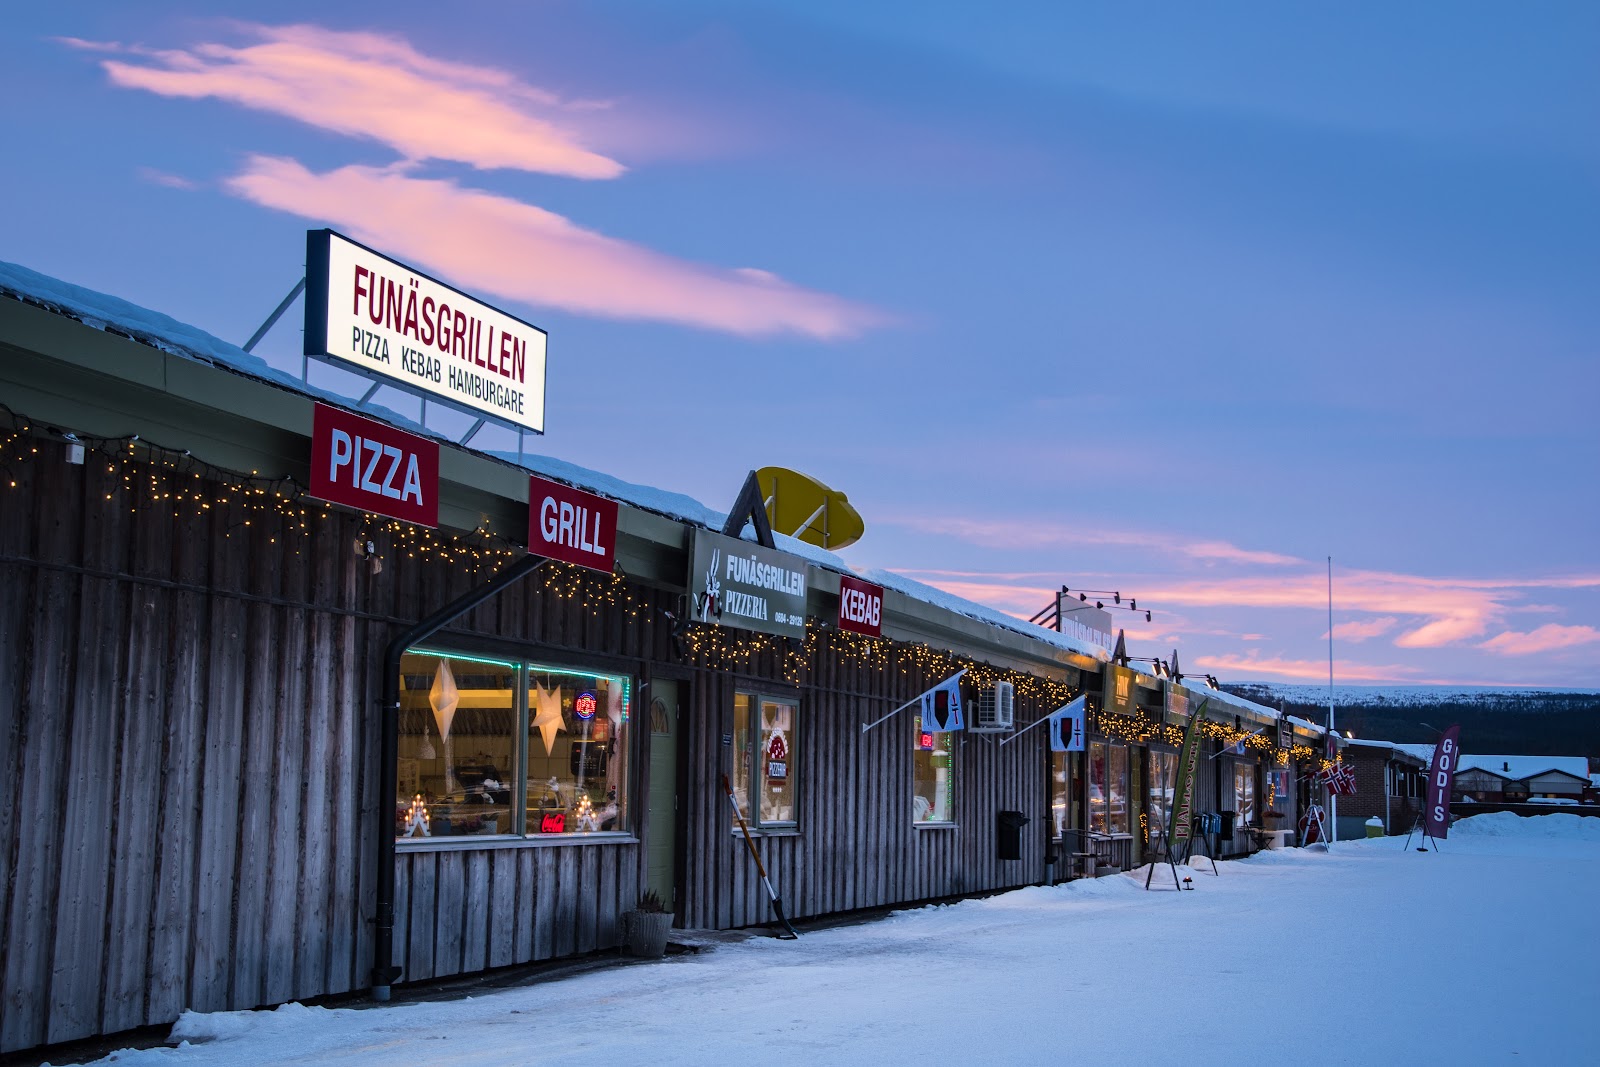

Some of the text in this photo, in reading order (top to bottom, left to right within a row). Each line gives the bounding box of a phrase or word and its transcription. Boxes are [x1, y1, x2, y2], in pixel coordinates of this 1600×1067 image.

[353, 264, 527, 384] FUNÄSGRILLEN
[352, 326, 525, 416] PIZZA KEBAB HAMBURGARE
[329, 428, 424, 507] PIZZA
[540, 496, 606, 556] GRILL
[725, 589, 768, 621] PIZZERIA
[726, 554, 805, 597] FUNÄSGRILLEN
[841, 587, 881, 627] KEBAB
[1433, 738, 1453, 822] GODIS
